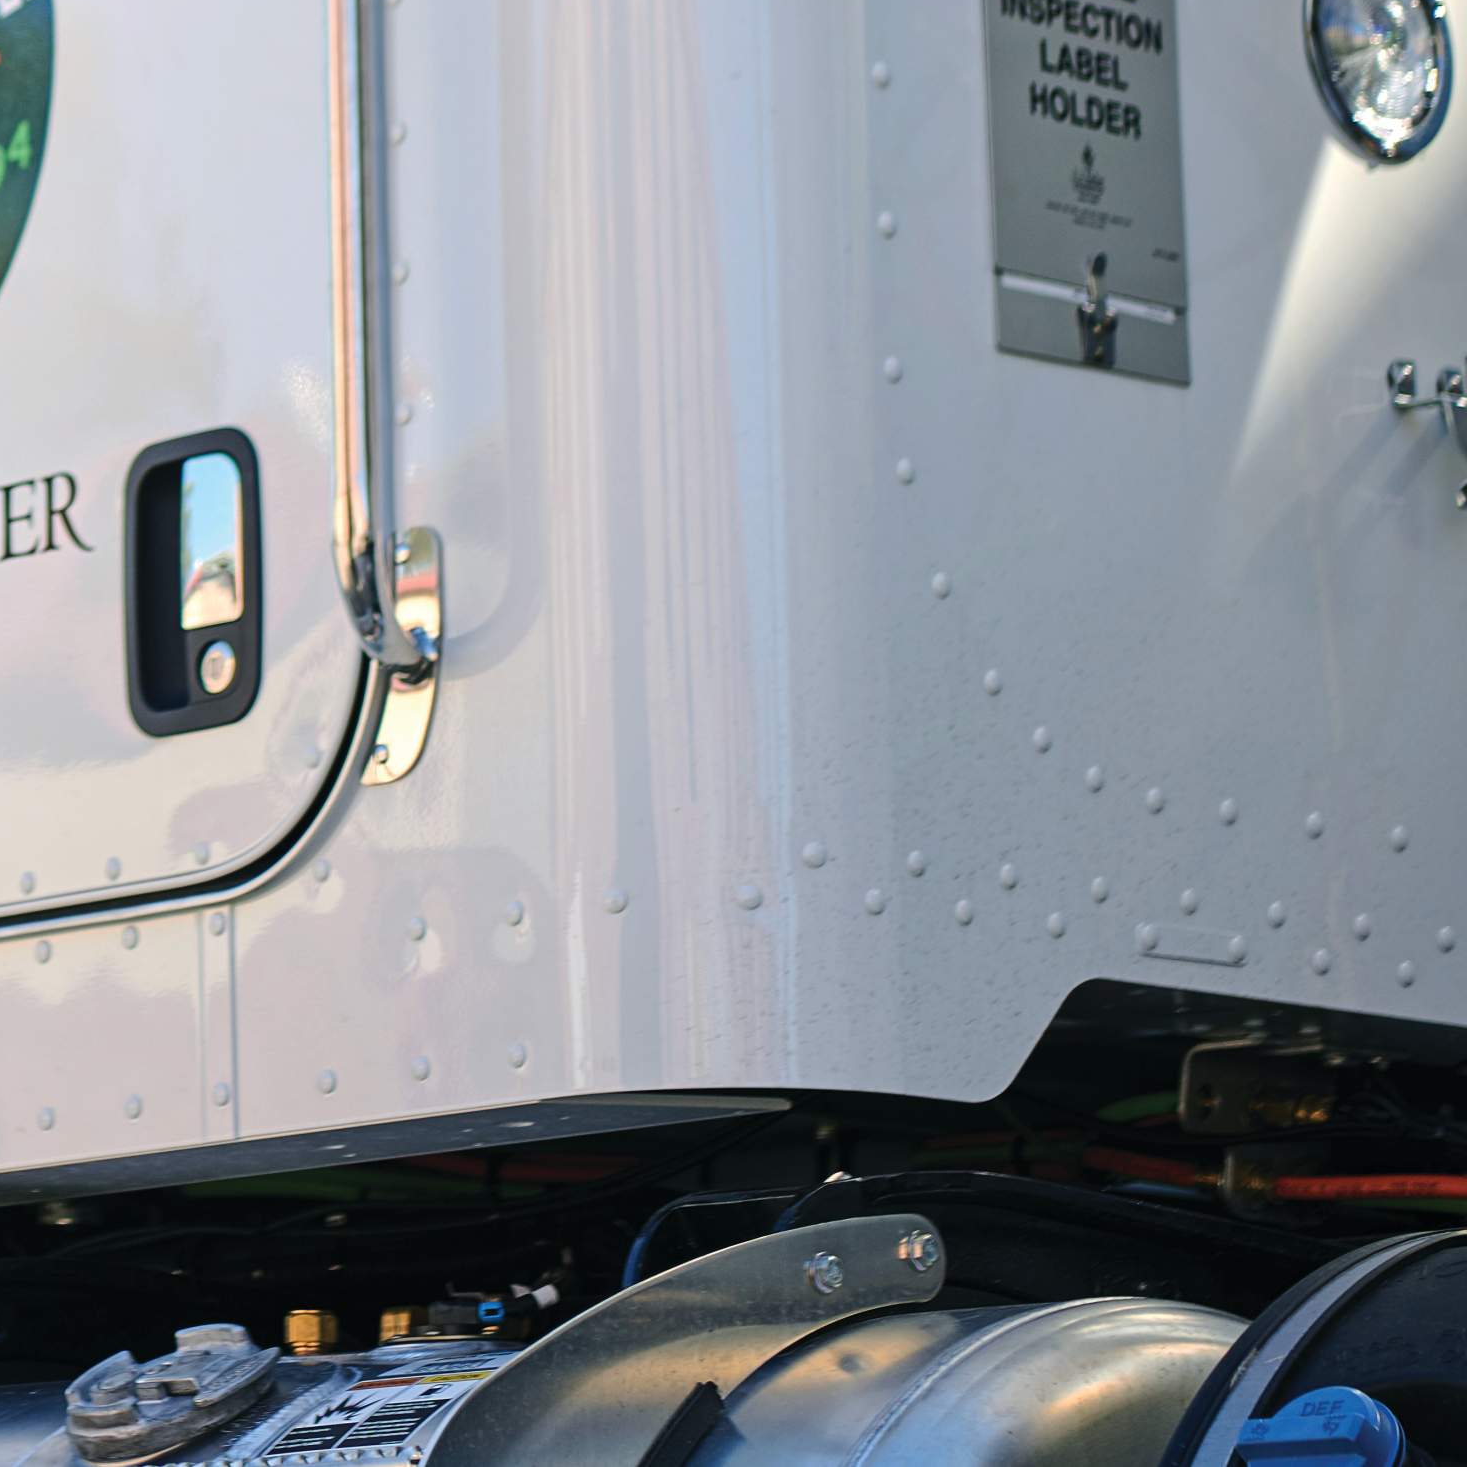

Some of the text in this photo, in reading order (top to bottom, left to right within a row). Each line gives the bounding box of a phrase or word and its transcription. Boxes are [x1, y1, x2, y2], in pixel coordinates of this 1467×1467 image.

[1039, 38, 1129, 92] LABEL
[1029, 82, 1142, 141] HOLDER
[1299, 1400, 1346, 1417] DEF
